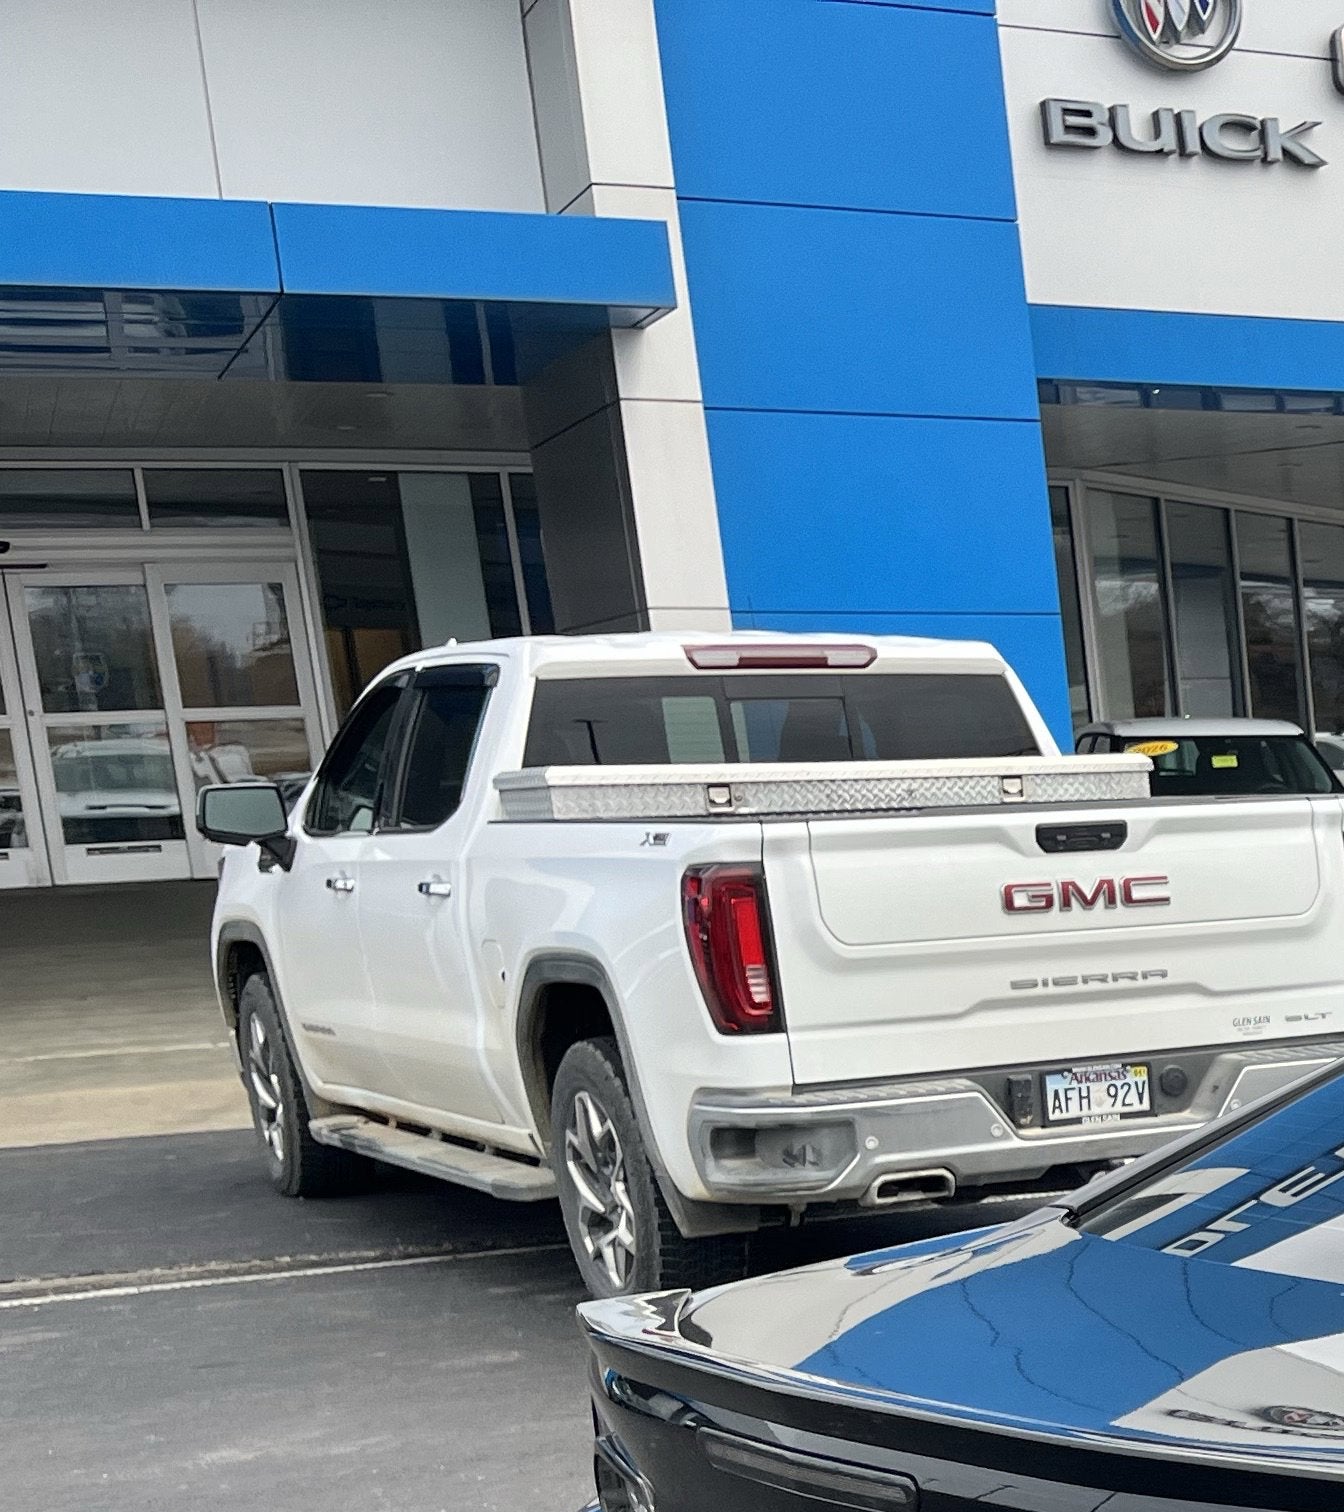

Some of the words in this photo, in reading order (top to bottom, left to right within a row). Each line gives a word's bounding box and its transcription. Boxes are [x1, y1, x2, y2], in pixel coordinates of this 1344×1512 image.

[1041, 98, 1329, 169] BUICK
[1001, 875, 1171, 915] GMC
[1010, 968, 1168, 990] SIERRA
[1068, 1069, 1128, 1085] Arkansas
[1052, 1085, 1092, 1115] AFH
[1106, 1080, 1147, 1108] 92V
